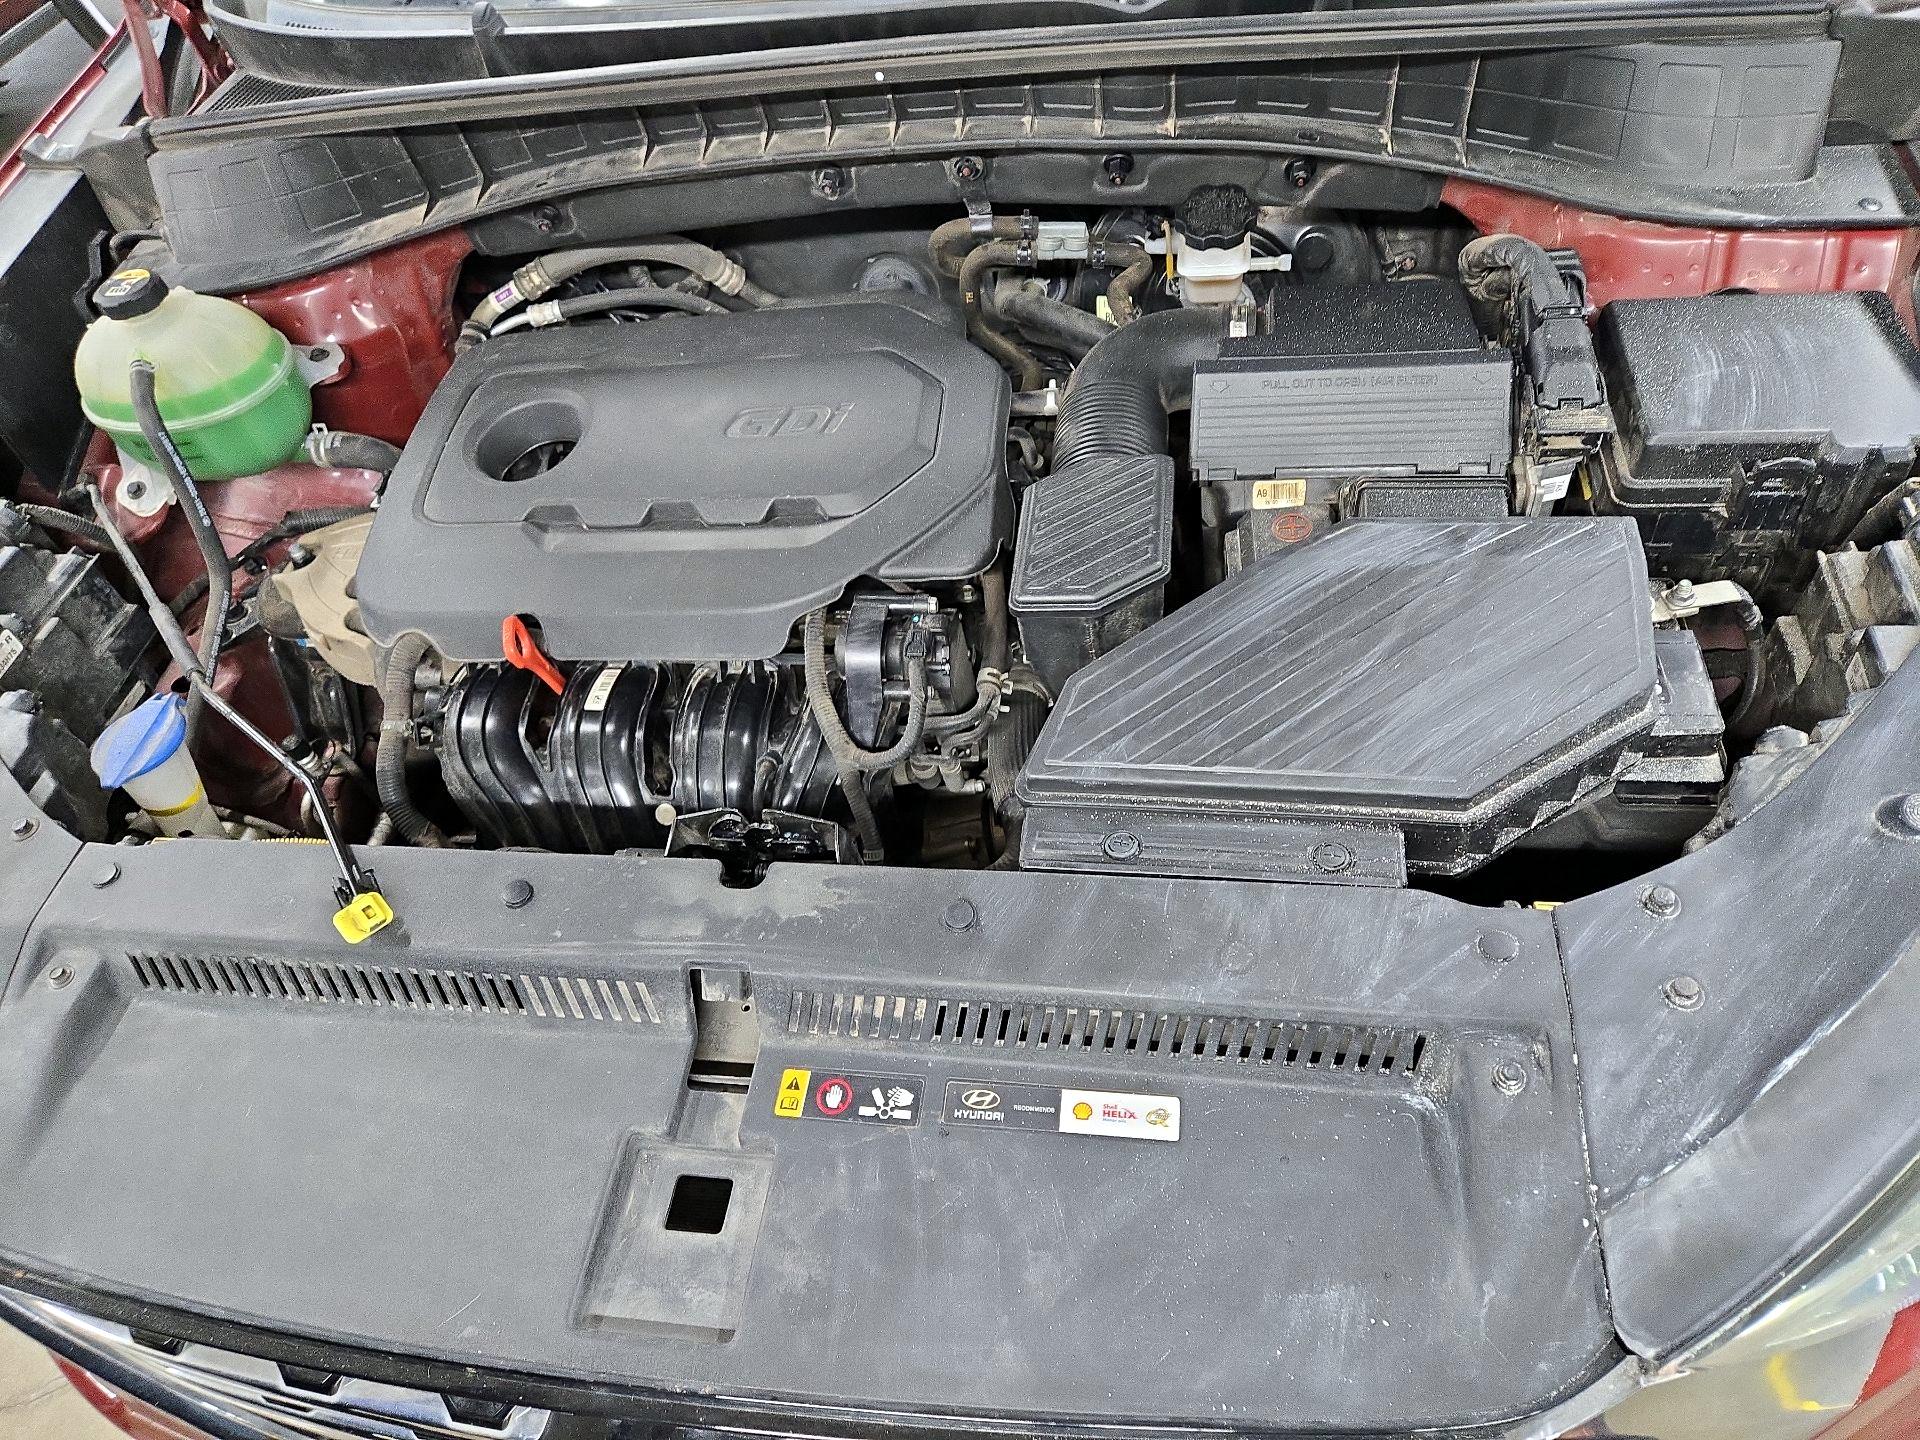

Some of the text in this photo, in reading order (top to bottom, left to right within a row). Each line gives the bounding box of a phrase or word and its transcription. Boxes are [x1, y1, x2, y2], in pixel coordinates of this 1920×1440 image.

[1262, 379, 1290, 389] PULL
[1293, 378, 1316, 388] OUT
[1317, 377, 1333, 387] TO
[1335, 376, 1367, 387] OPEN
[1256, 488, 1268, 498] A9
[953, 1108, 1005, 1123] HYUNDAI
[1102, 1108, 1138, 1120] HELIX
